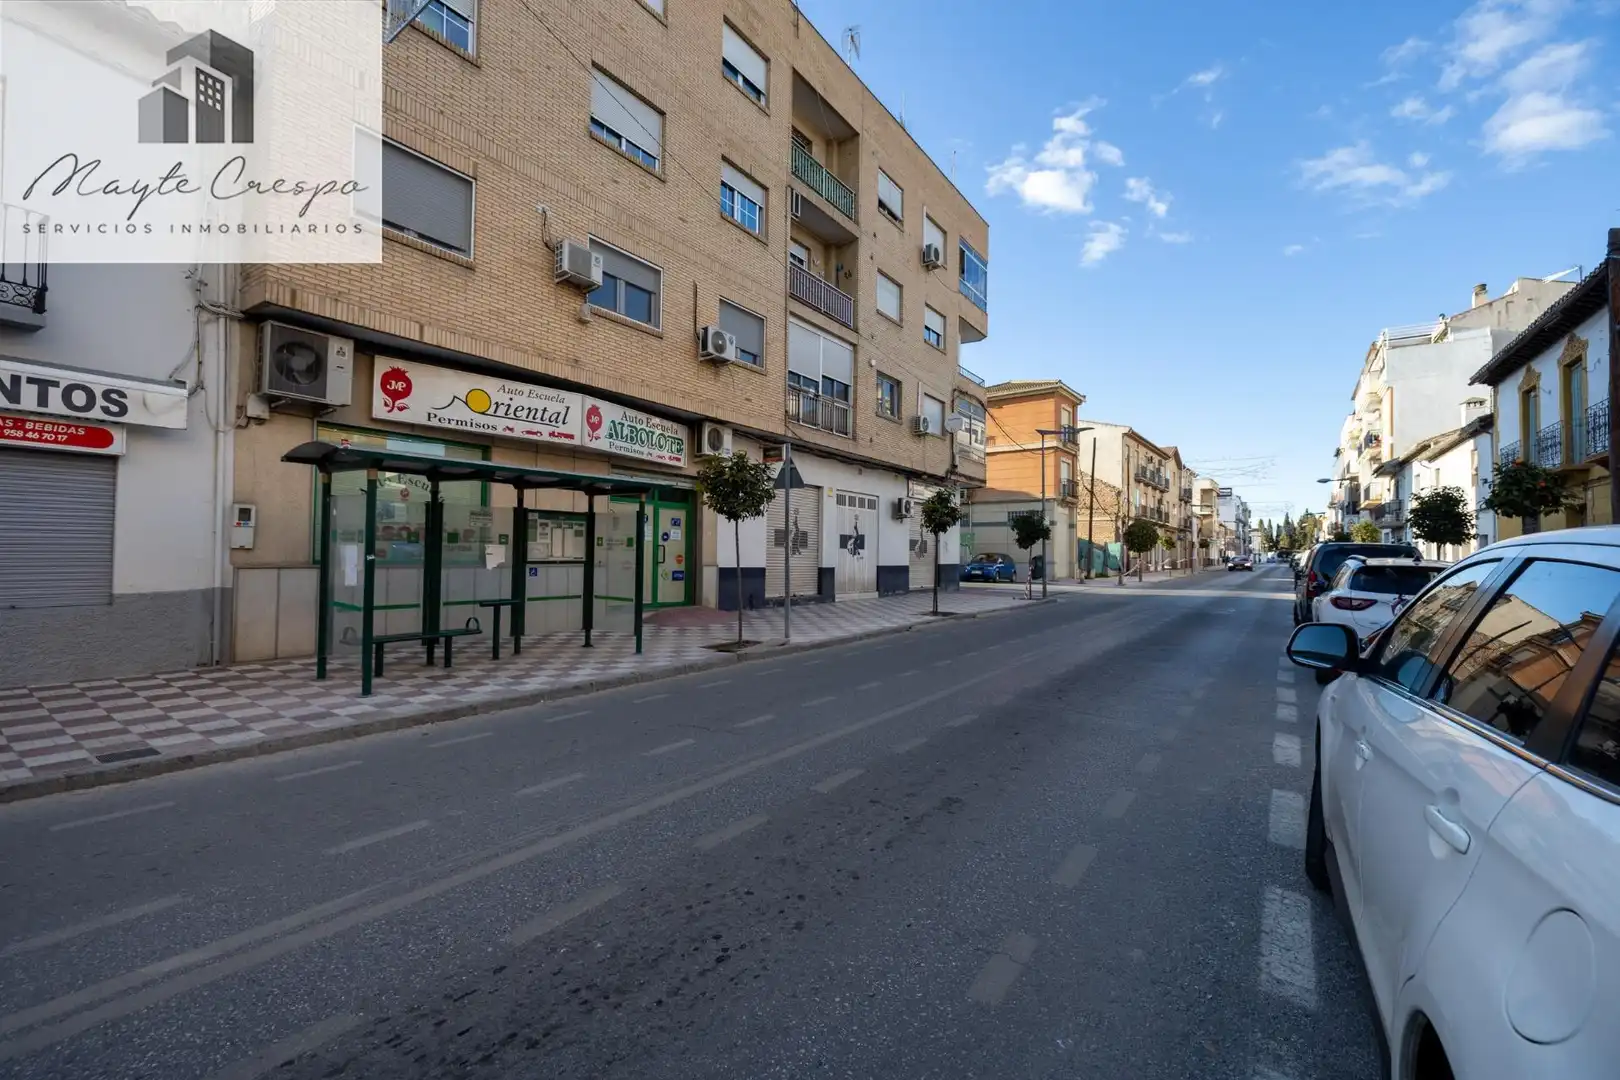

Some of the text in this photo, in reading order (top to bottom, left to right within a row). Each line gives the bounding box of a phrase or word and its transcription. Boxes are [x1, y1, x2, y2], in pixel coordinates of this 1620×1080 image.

[497, 384, 566, 404] Auto Escuela
[25, 421, 86, 435] BEBIDAS
[426, 412, 498, 431] Permisos
[620, 411, 678, 435] Auto Escuela
[3, 428, 68, 442] 958 46 70 17
[605, 419, 684, 455] ALBOLOTE
[609, 441, 646, 455] Permisos
